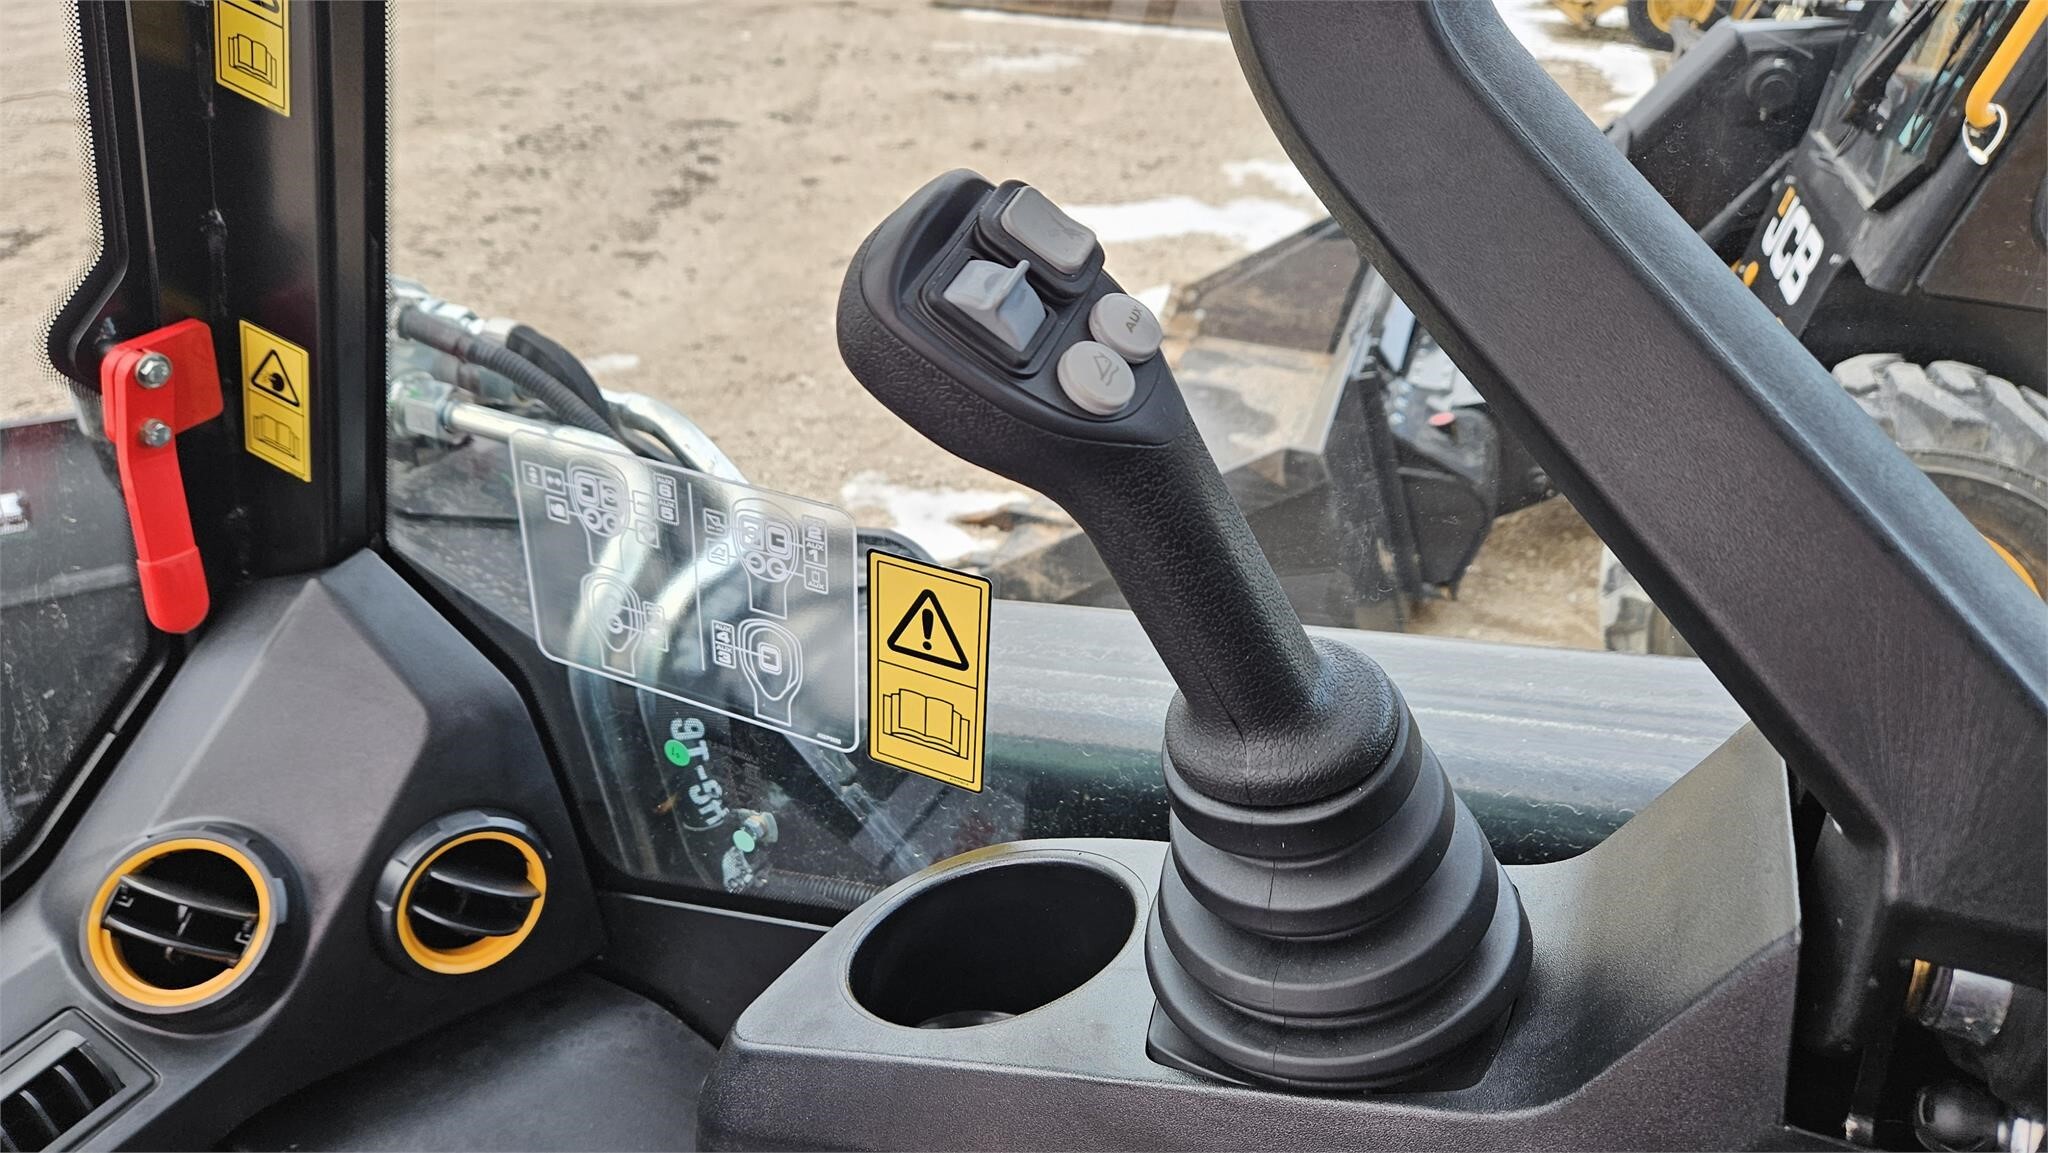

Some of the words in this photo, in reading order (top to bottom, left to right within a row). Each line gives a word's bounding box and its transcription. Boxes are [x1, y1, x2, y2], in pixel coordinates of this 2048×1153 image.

[1761, 195, 1825, 306] JCB
[1126, 306, 1144, 333] AUX
[806, 542, 825, 552] AUX
[808, 549, 818, 562] 1
[807, 581, 825, 590] AUX
